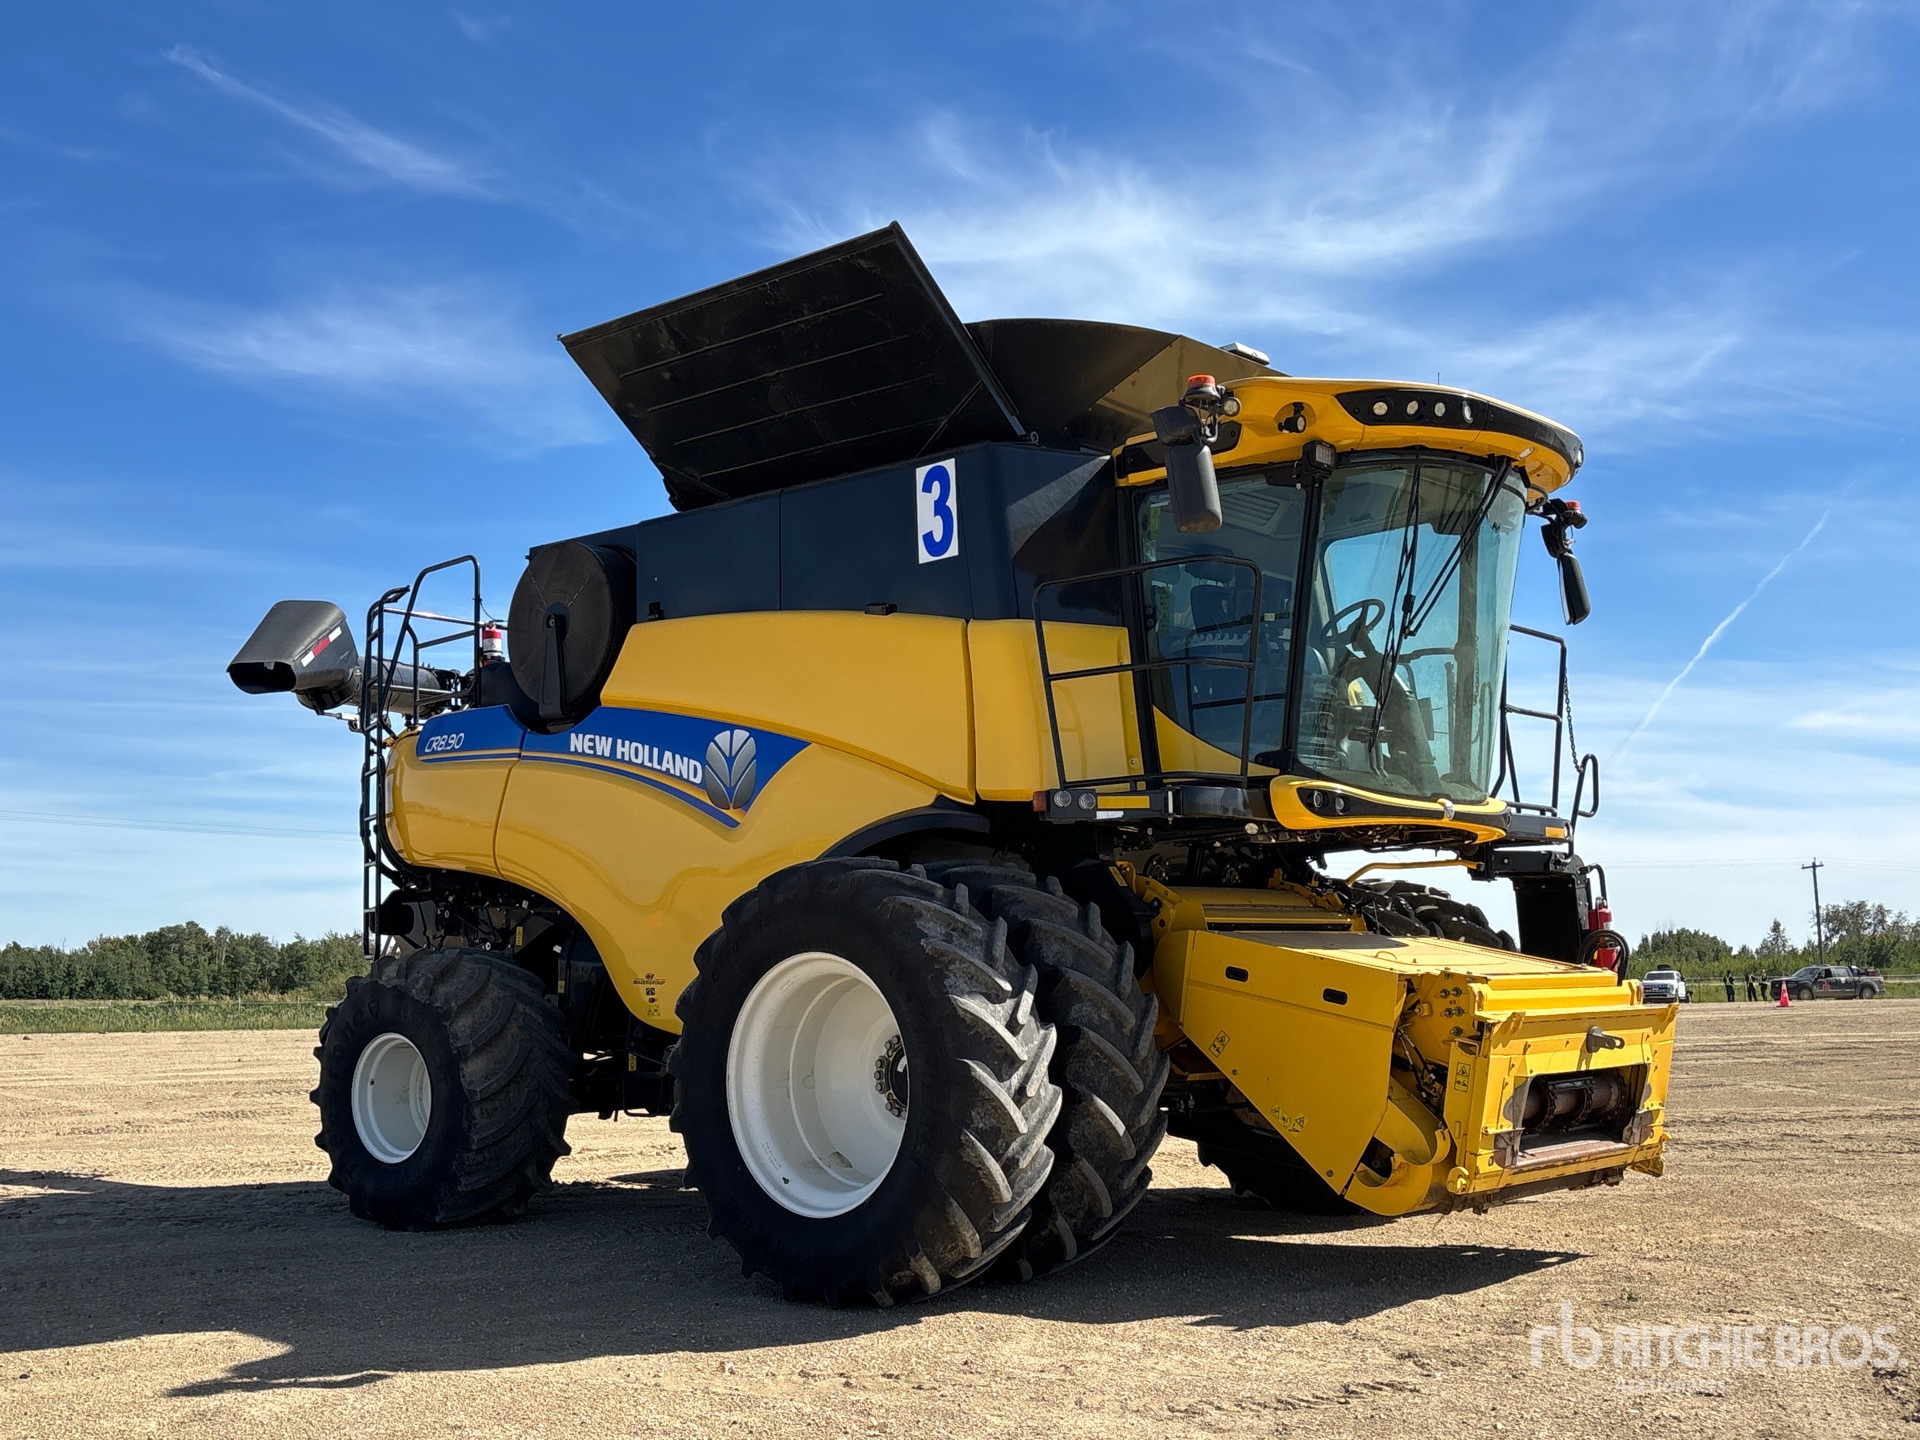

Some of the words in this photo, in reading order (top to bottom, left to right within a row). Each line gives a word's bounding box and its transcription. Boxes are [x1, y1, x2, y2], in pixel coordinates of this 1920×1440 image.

[921, 464, 954, 558] 3
[424, 732, 465, 753] CR8.90
[569, 732, 613, 758] NEW
[616, 738, 703, 785] HOLLAND
